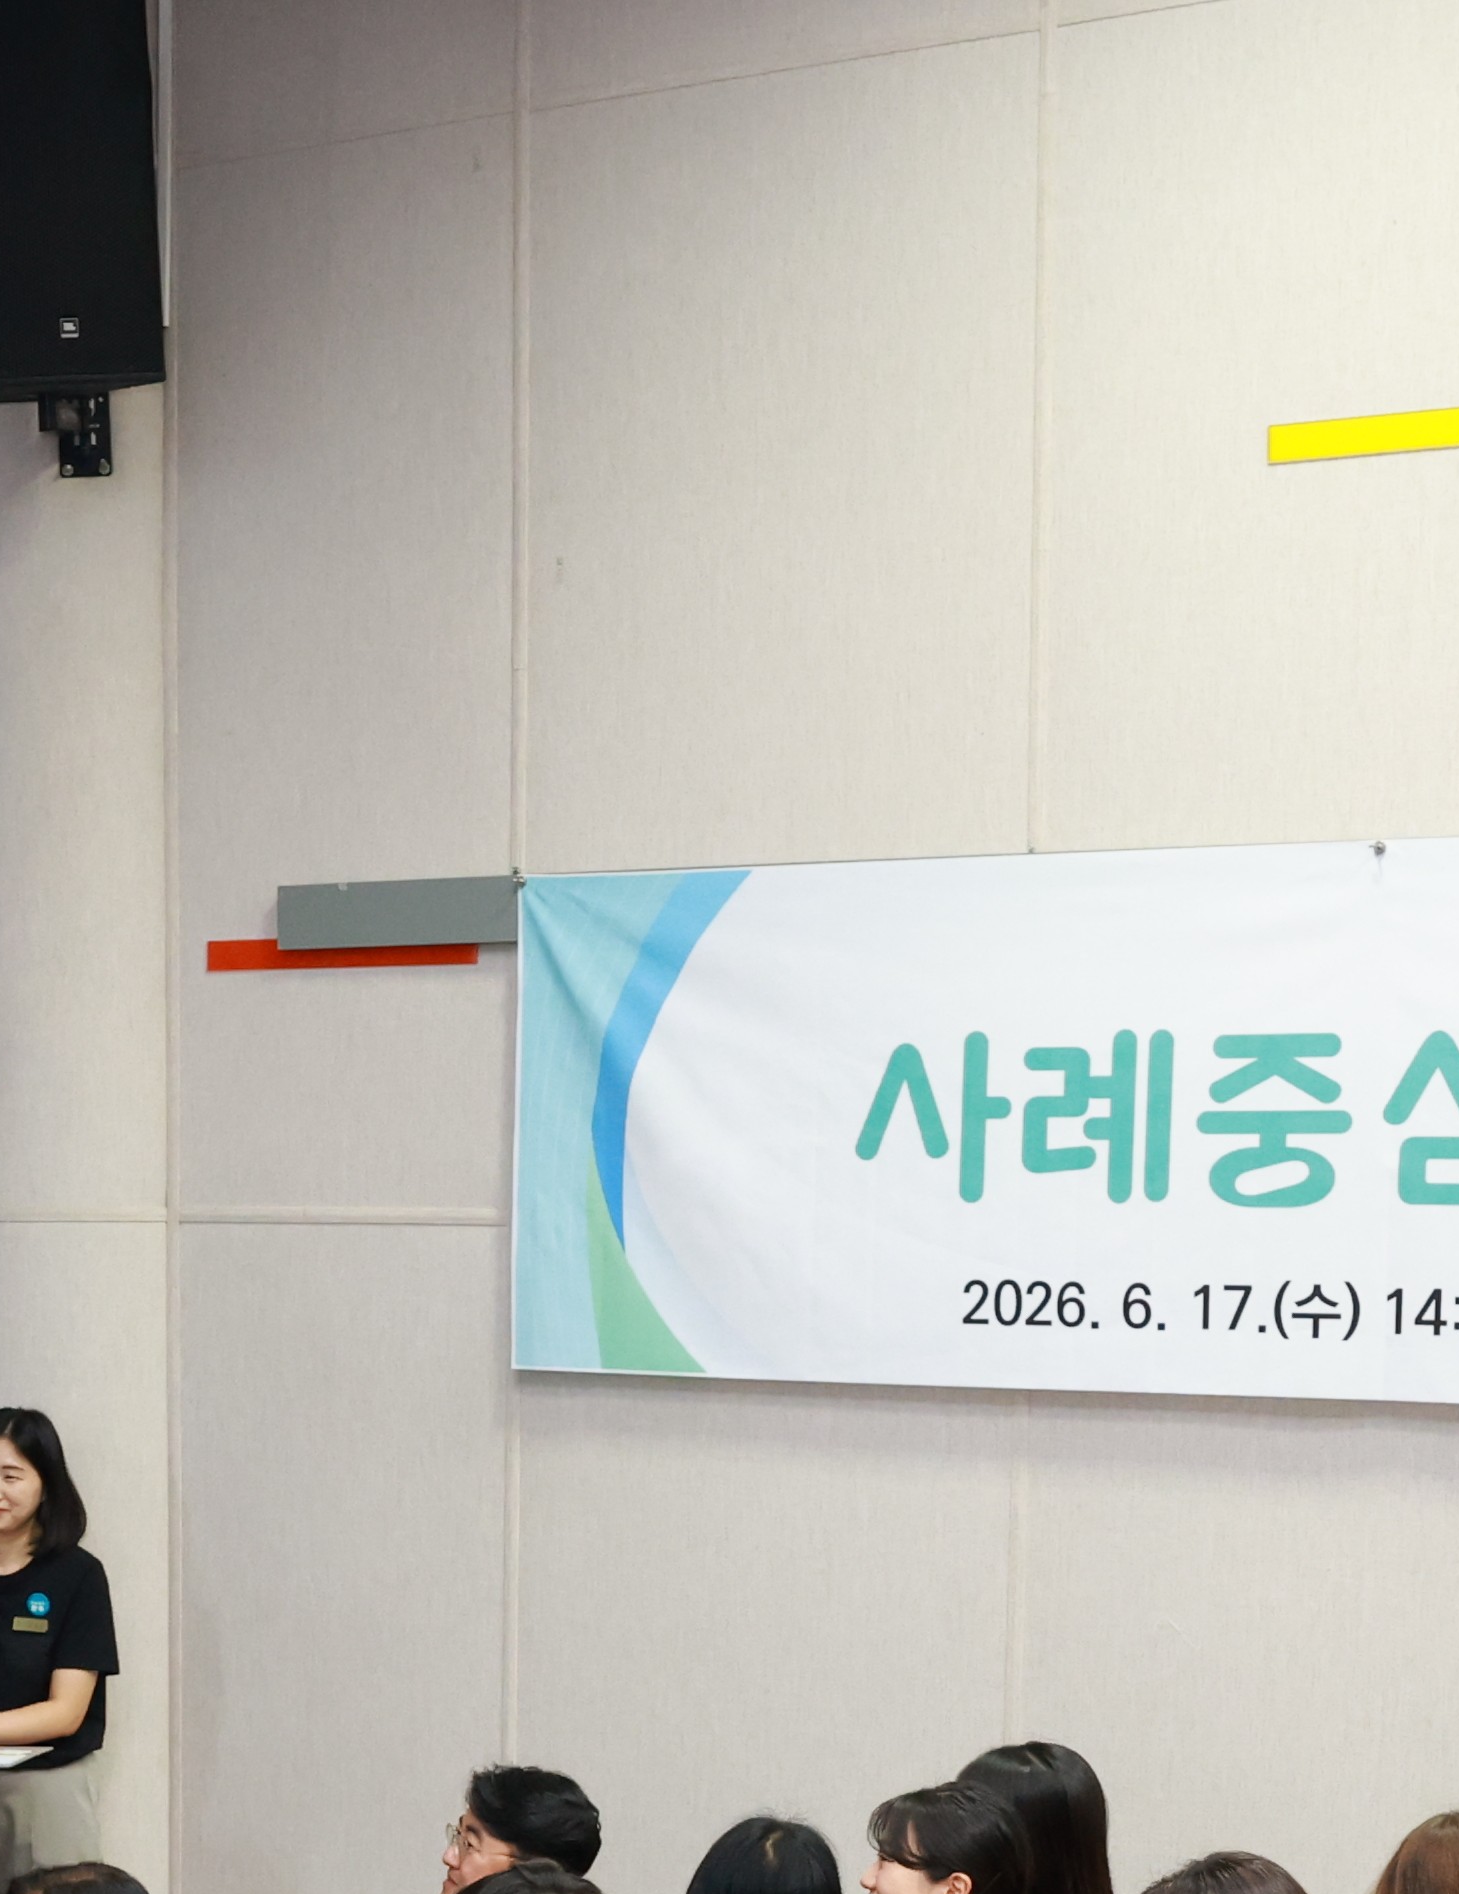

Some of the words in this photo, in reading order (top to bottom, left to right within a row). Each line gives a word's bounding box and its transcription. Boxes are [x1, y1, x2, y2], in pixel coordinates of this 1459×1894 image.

[961, 1278, 1100, 1330] 2026.
[1122, 1281, 1166, 1332] 6.
[1193, 1279, 1361, 1342] 17.(수)
